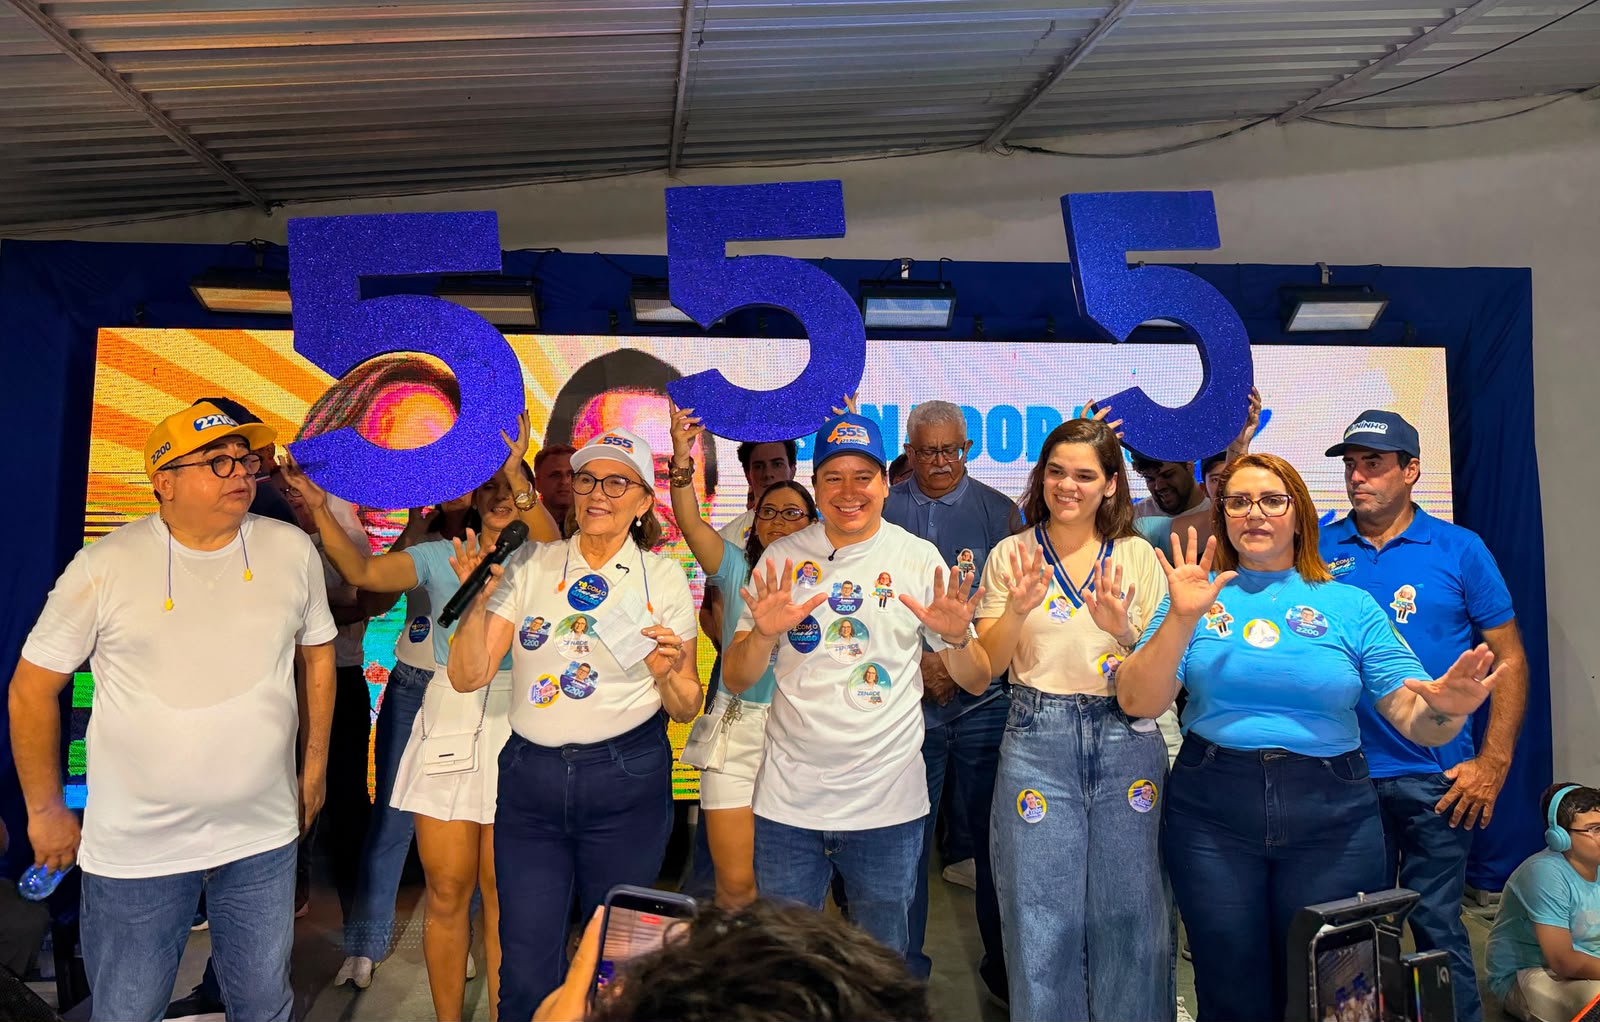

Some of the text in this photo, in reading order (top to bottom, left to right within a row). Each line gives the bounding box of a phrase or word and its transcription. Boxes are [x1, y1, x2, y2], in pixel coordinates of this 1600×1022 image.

[288, 180, 1254, 509] 5 5 5
[837, 426, 867, 438] 555
[603, 436, 634, 449] 555
[151, 441, 171, 465] 2200
[875, 587, 893, 598] 555
[836, 604, 857, 612] 2200
[1295, 626, 1320, 637] 2200
[523, 638, 540, 648] 2200
[564, 684, 585, 698] 2200
